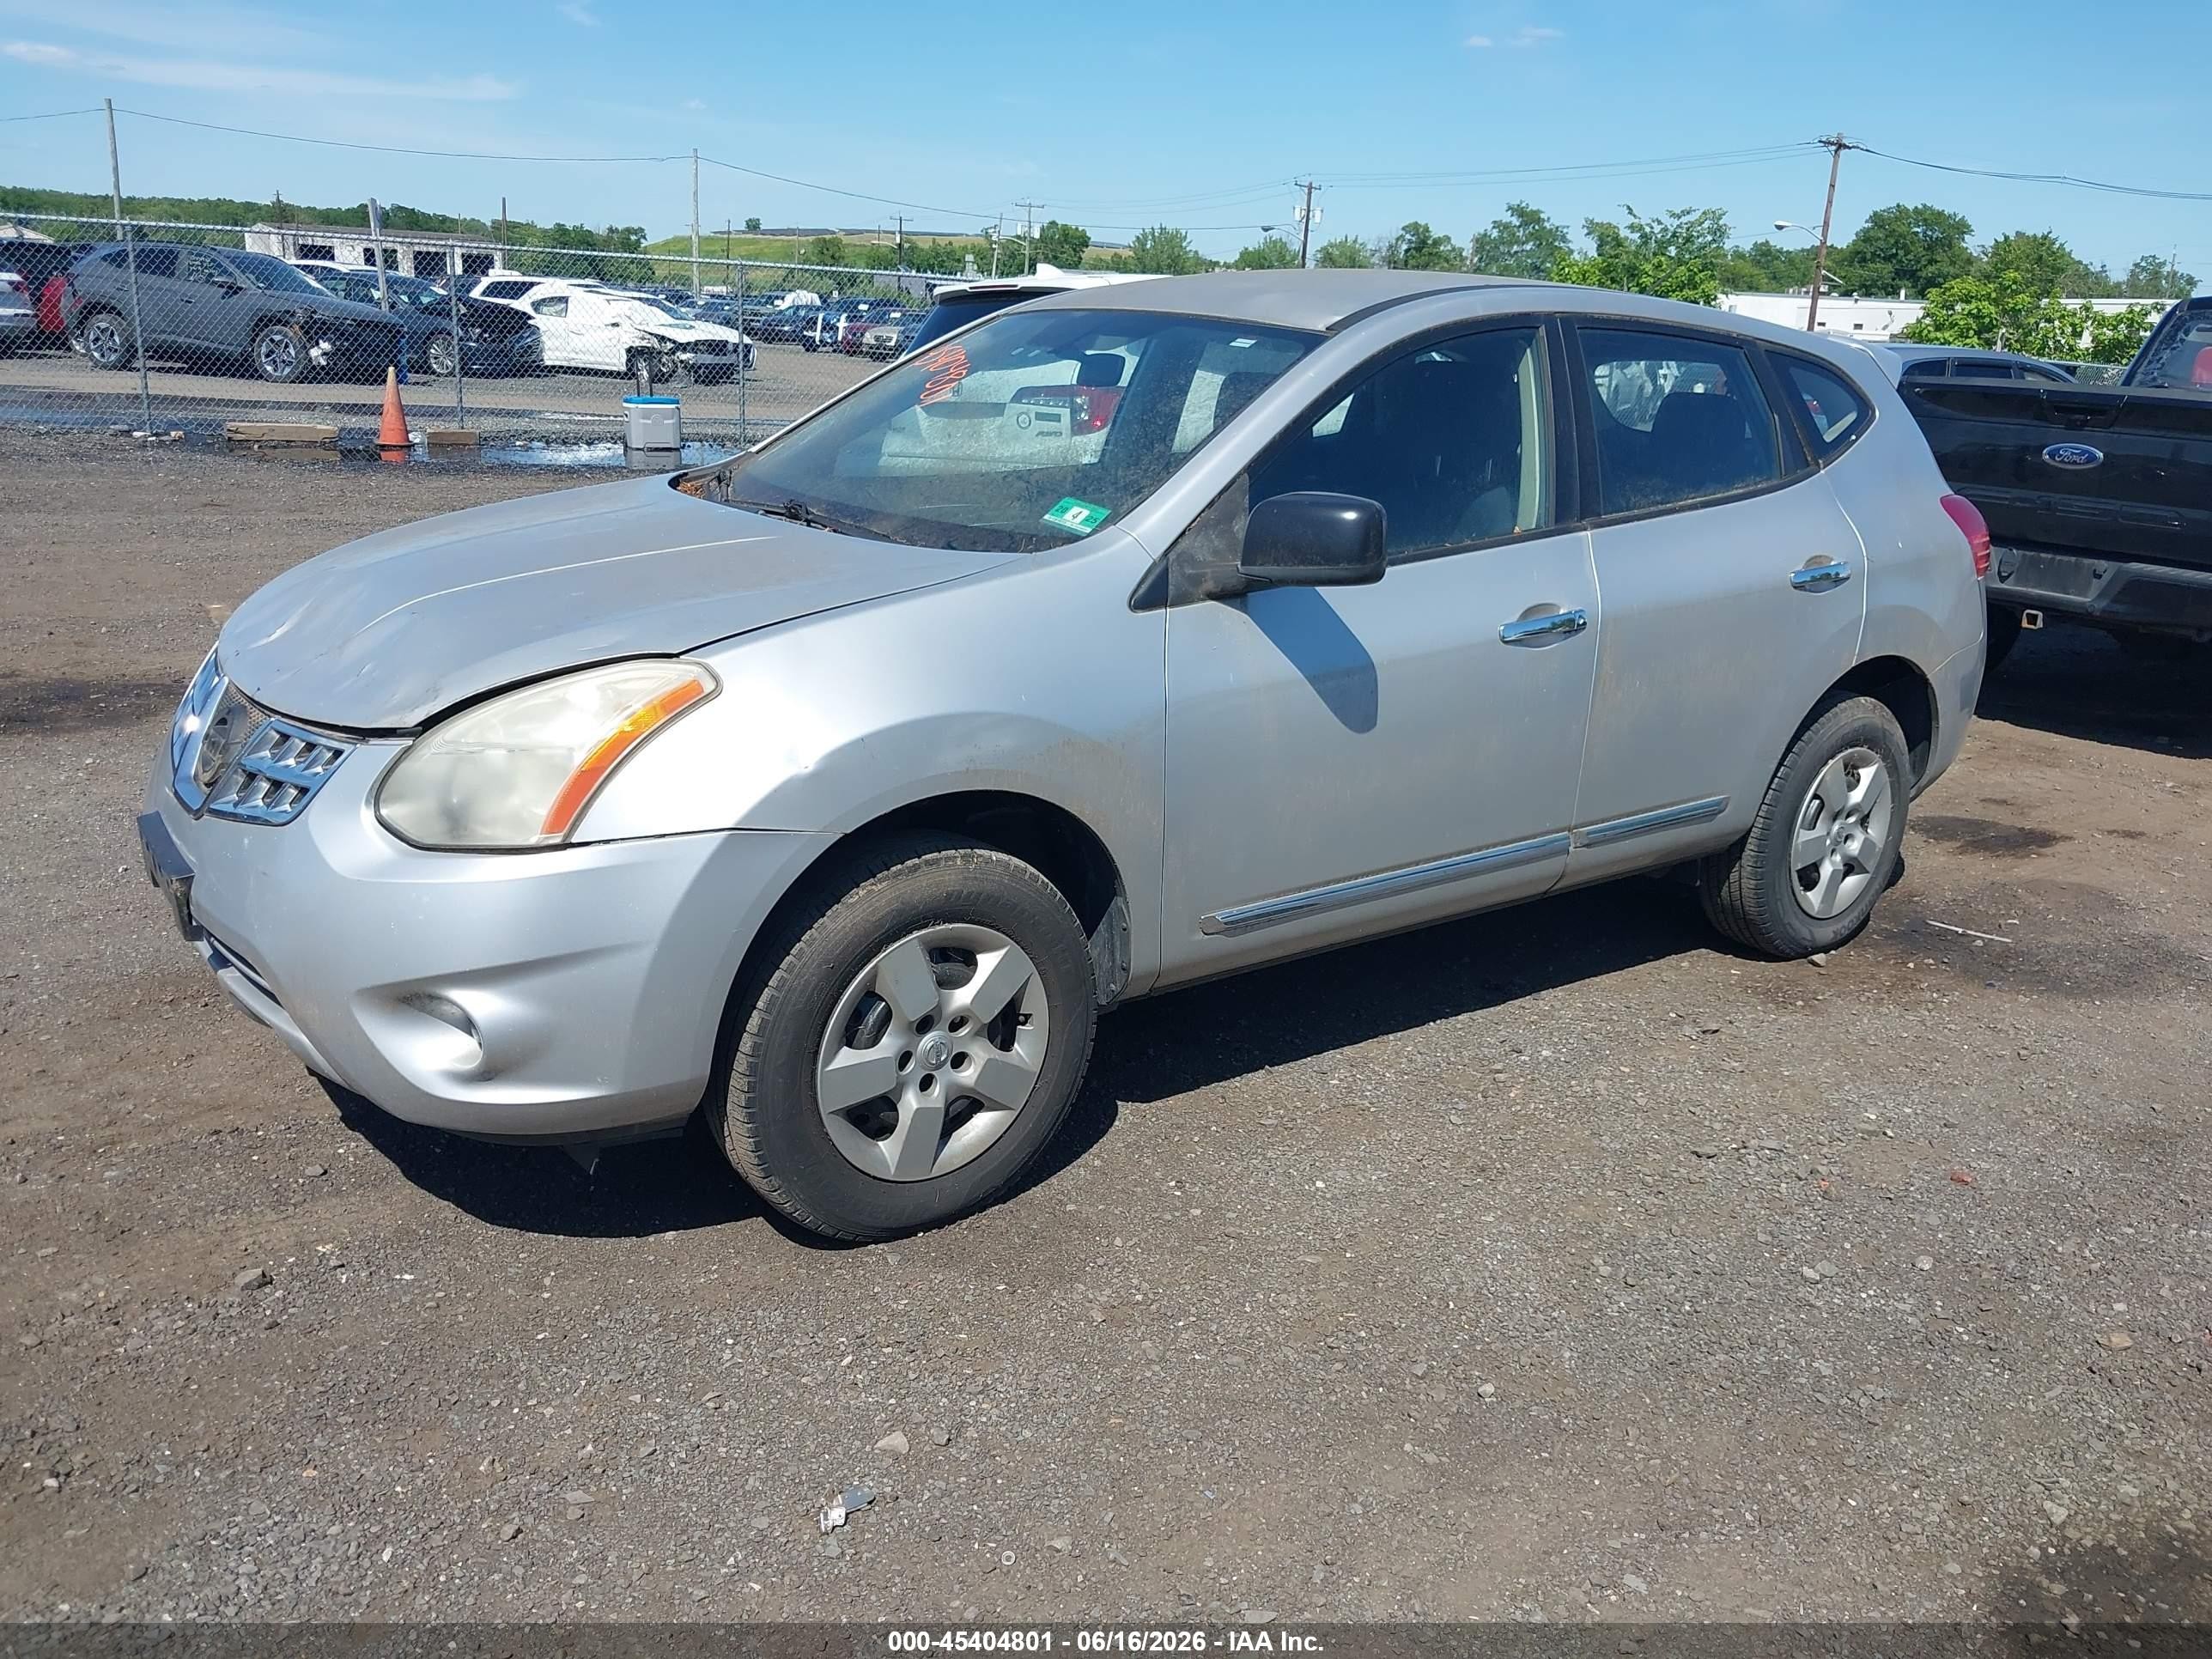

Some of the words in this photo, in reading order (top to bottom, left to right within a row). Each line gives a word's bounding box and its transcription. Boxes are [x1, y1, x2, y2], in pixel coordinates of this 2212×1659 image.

[2055, 447, 2088, 463] Ford
[1054, 505, 1069, 514] 20
[1071, 510, 1084, 520] 4
[1085, 515, 1099, 524] 25
